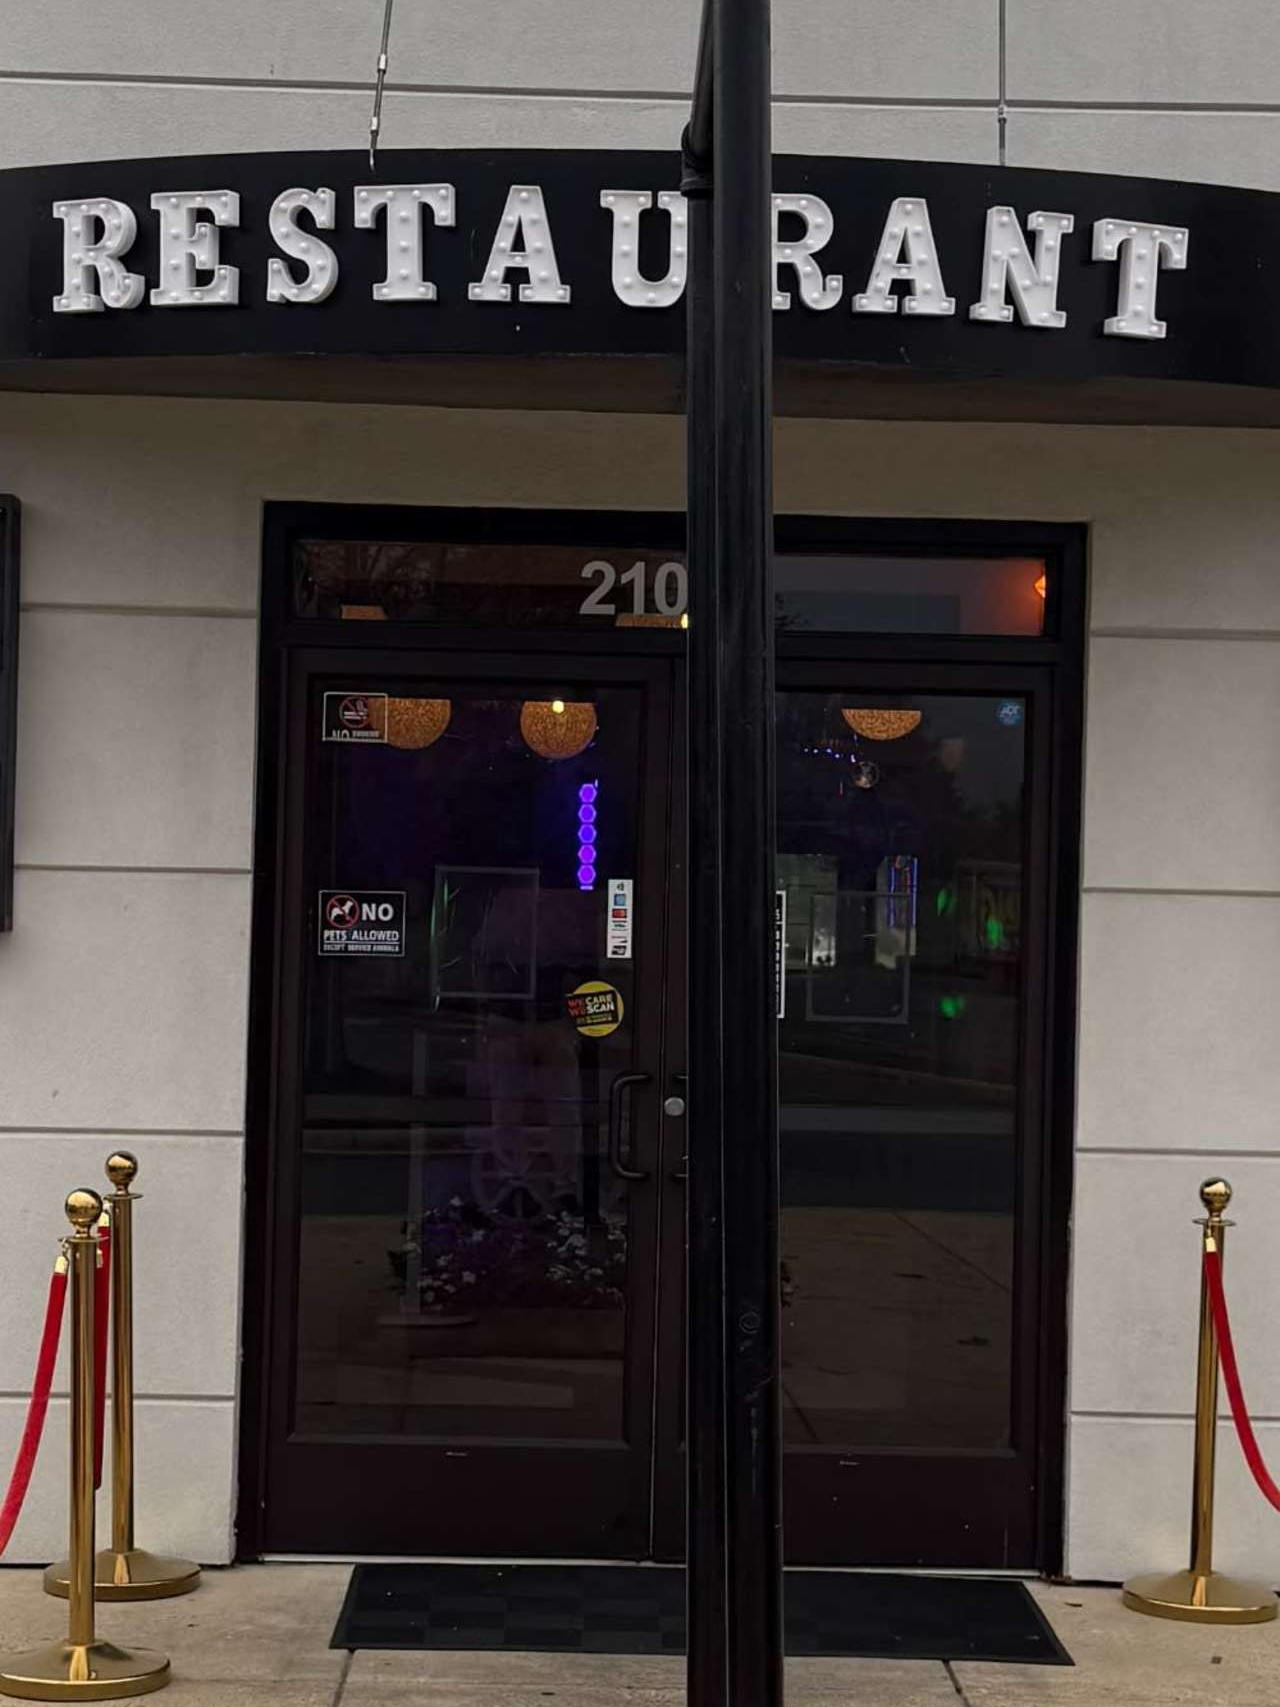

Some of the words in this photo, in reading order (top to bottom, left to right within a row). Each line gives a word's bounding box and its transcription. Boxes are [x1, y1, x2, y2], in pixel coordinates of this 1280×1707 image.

[52, 183, 1190, 340] RESTAURANT
[580, 560, 688, 616] 210
[361, 902, 394, 922] NO
[323, 929, 347, 942] PETS
[351, 929, 399, 942] ALLOWED
